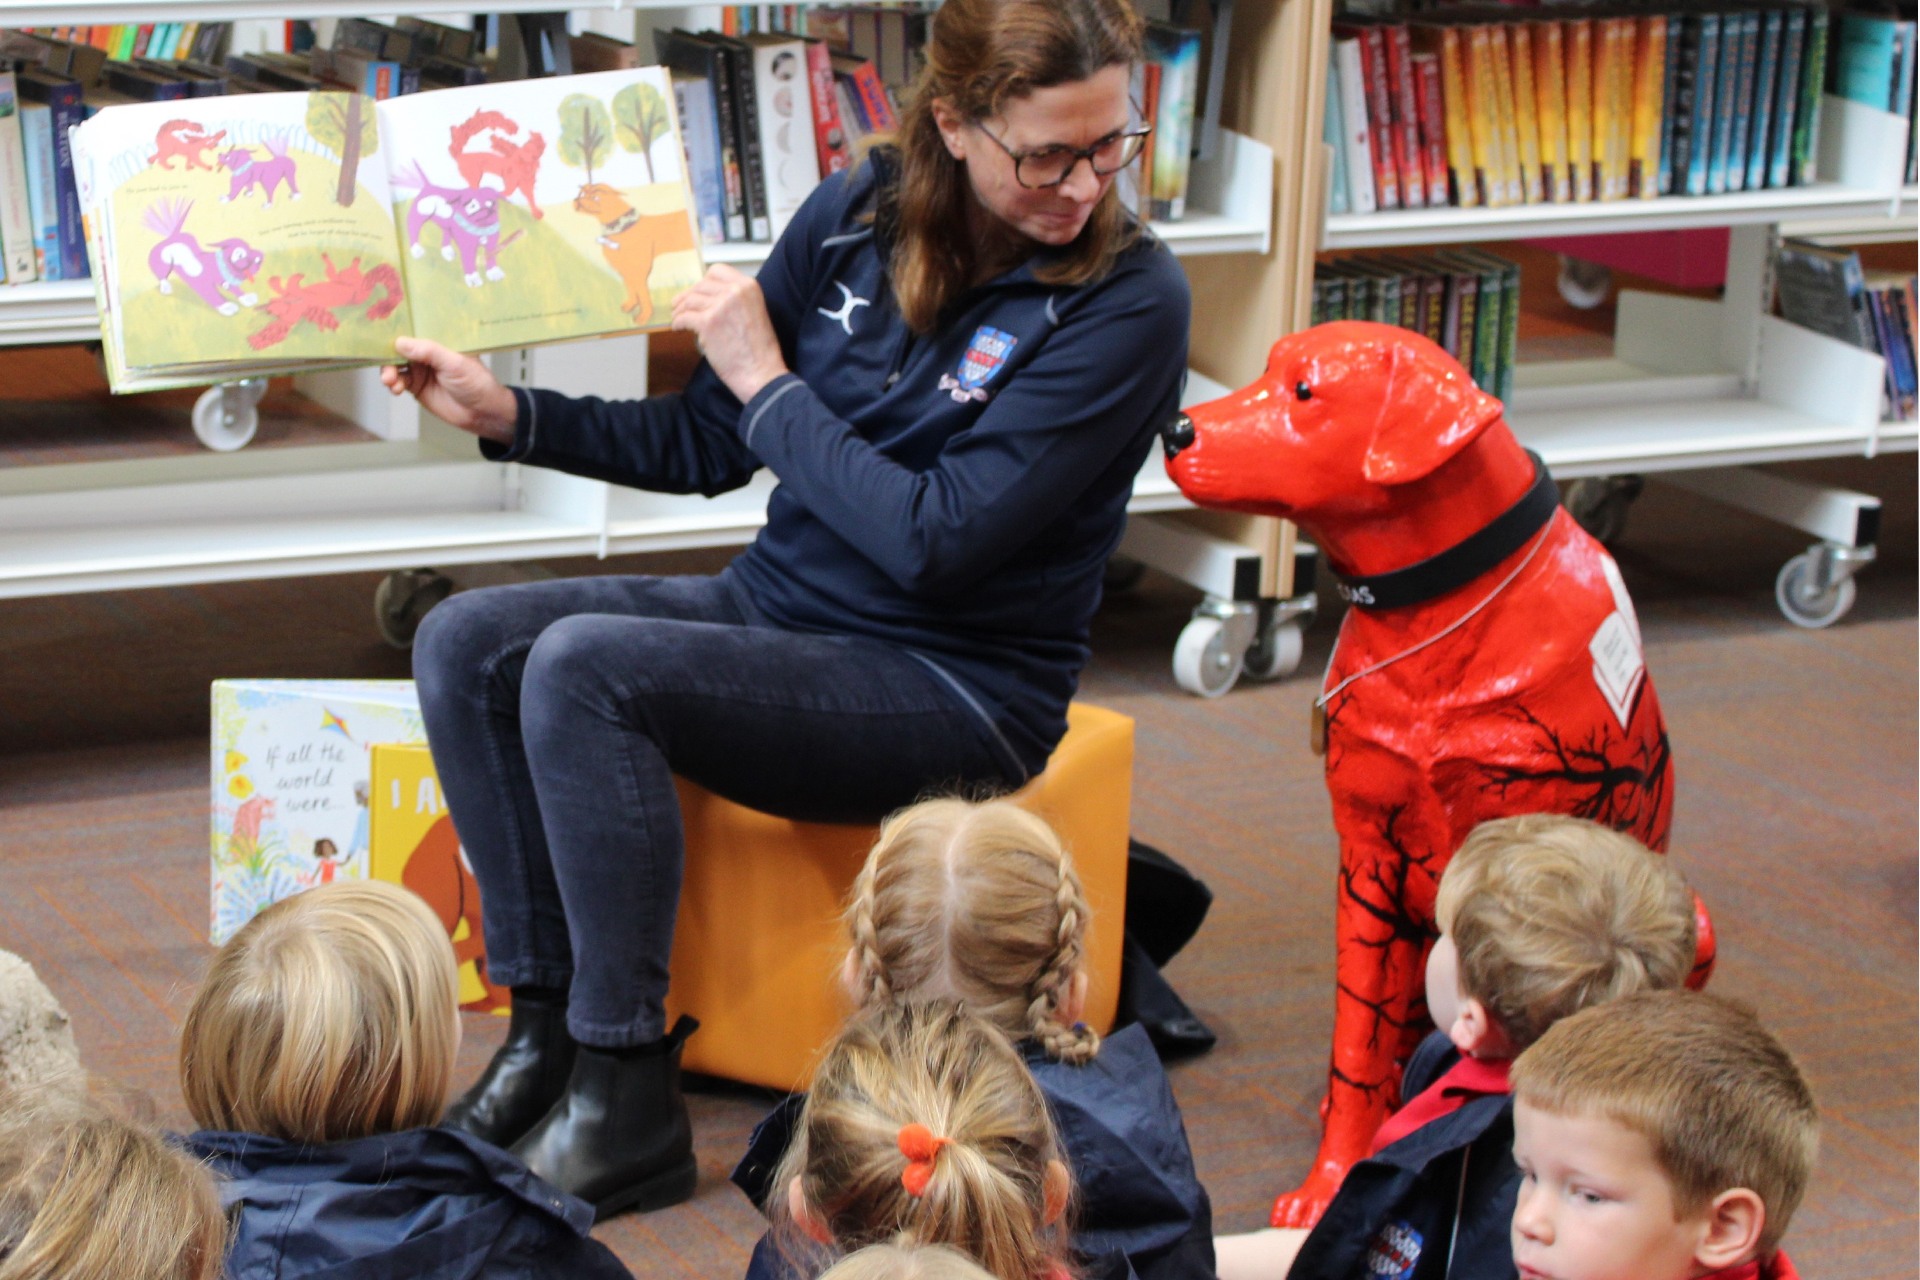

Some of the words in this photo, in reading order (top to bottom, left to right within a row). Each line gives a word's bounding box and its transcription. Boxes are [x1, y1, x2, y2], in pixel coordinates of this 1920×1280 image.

[266, 744, 281, 770] If
[286, 742, 313, 764] all
[317, 742, 346, 763] the
[276, 767, 334, 790] world
[391, 779, 401, 809] I
